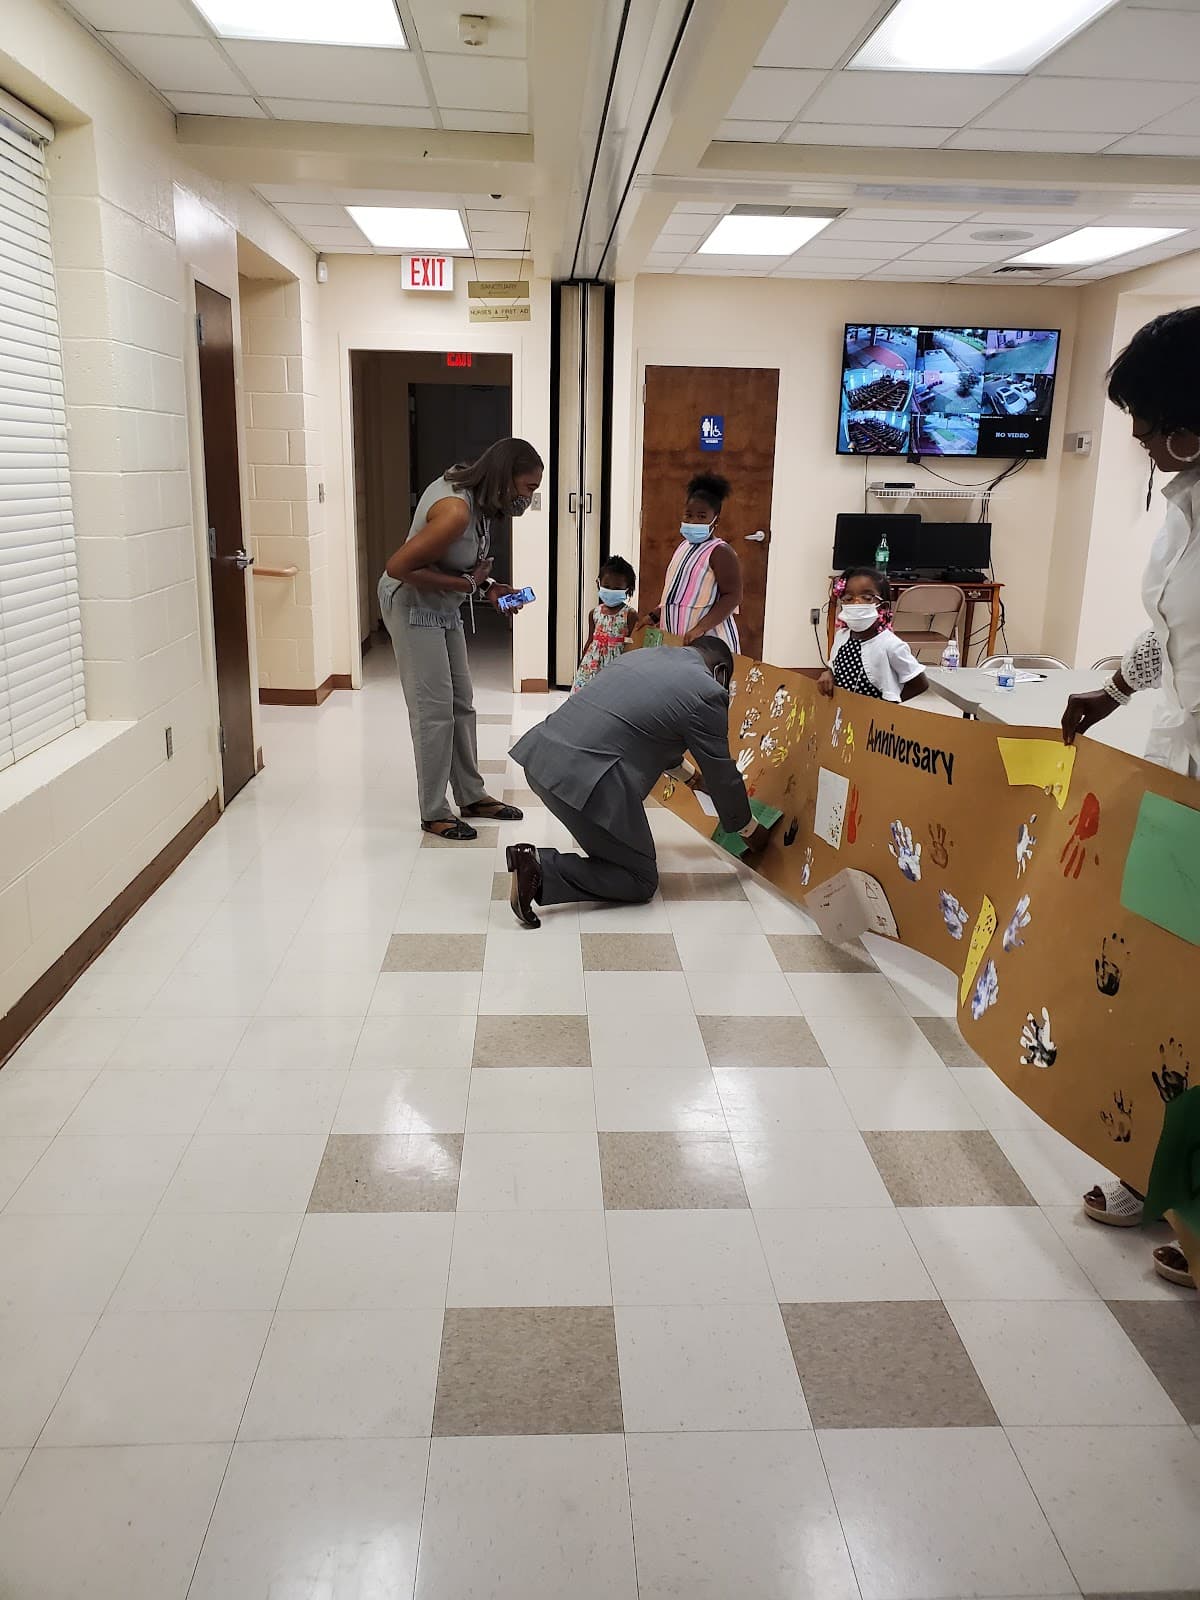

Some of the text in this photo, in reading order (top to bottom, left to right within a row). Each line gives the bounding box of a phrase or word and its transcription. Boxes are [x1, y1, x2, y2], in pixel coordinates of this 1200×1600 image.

[410, 257, 446, 287] EXIT
[447, 351, 472, 368] EXIT
[866, 718, 954, 785] Anniversary
